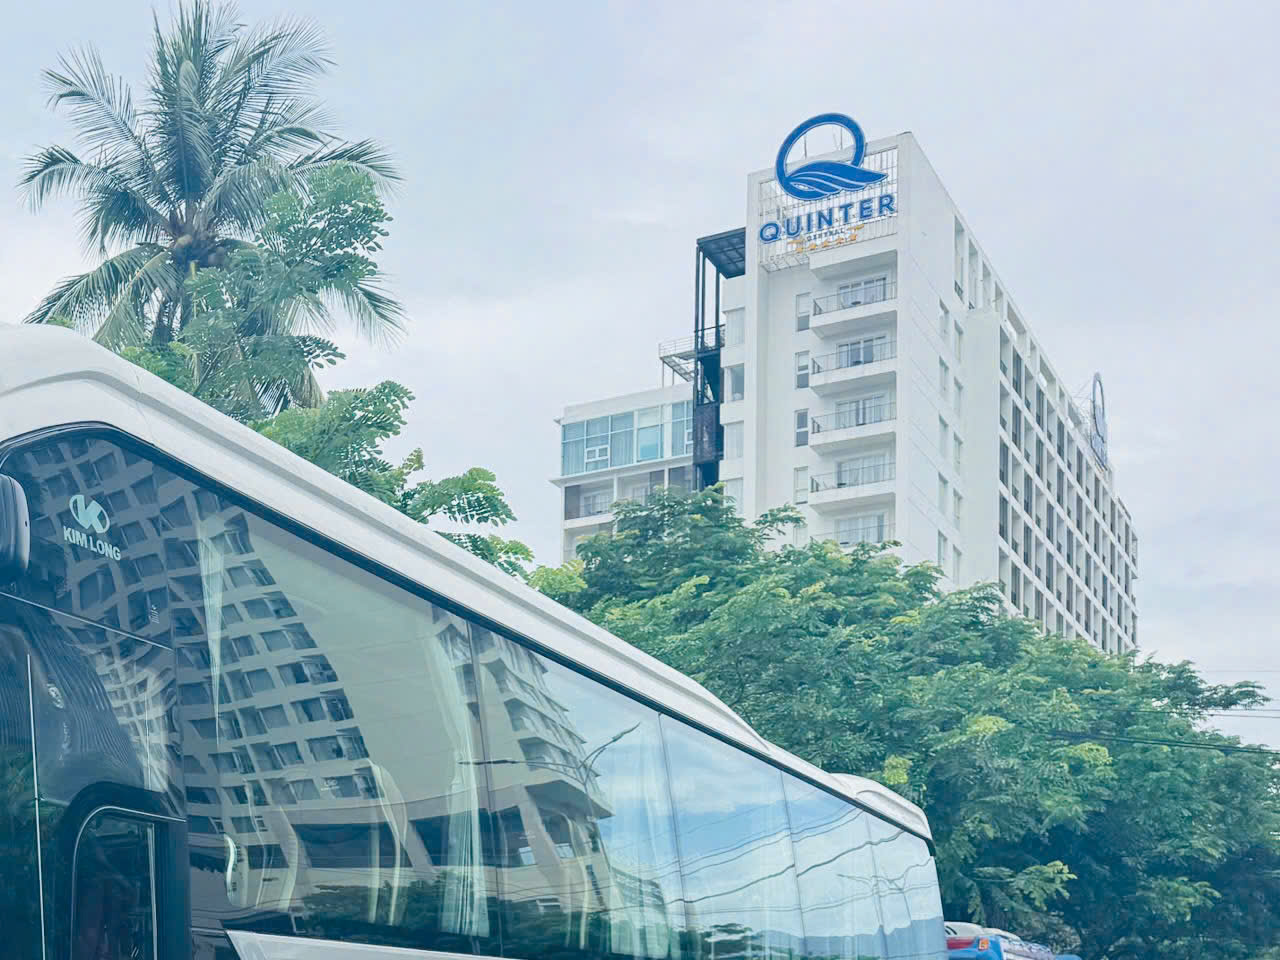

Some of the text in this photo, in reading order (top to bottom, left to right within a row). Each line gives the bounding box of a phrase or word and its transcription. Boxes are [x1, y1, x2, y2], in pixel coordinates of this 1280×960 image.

[759, 193, 896, 244] QUINTER
[63, 526, 121, 560] KIM LONG
